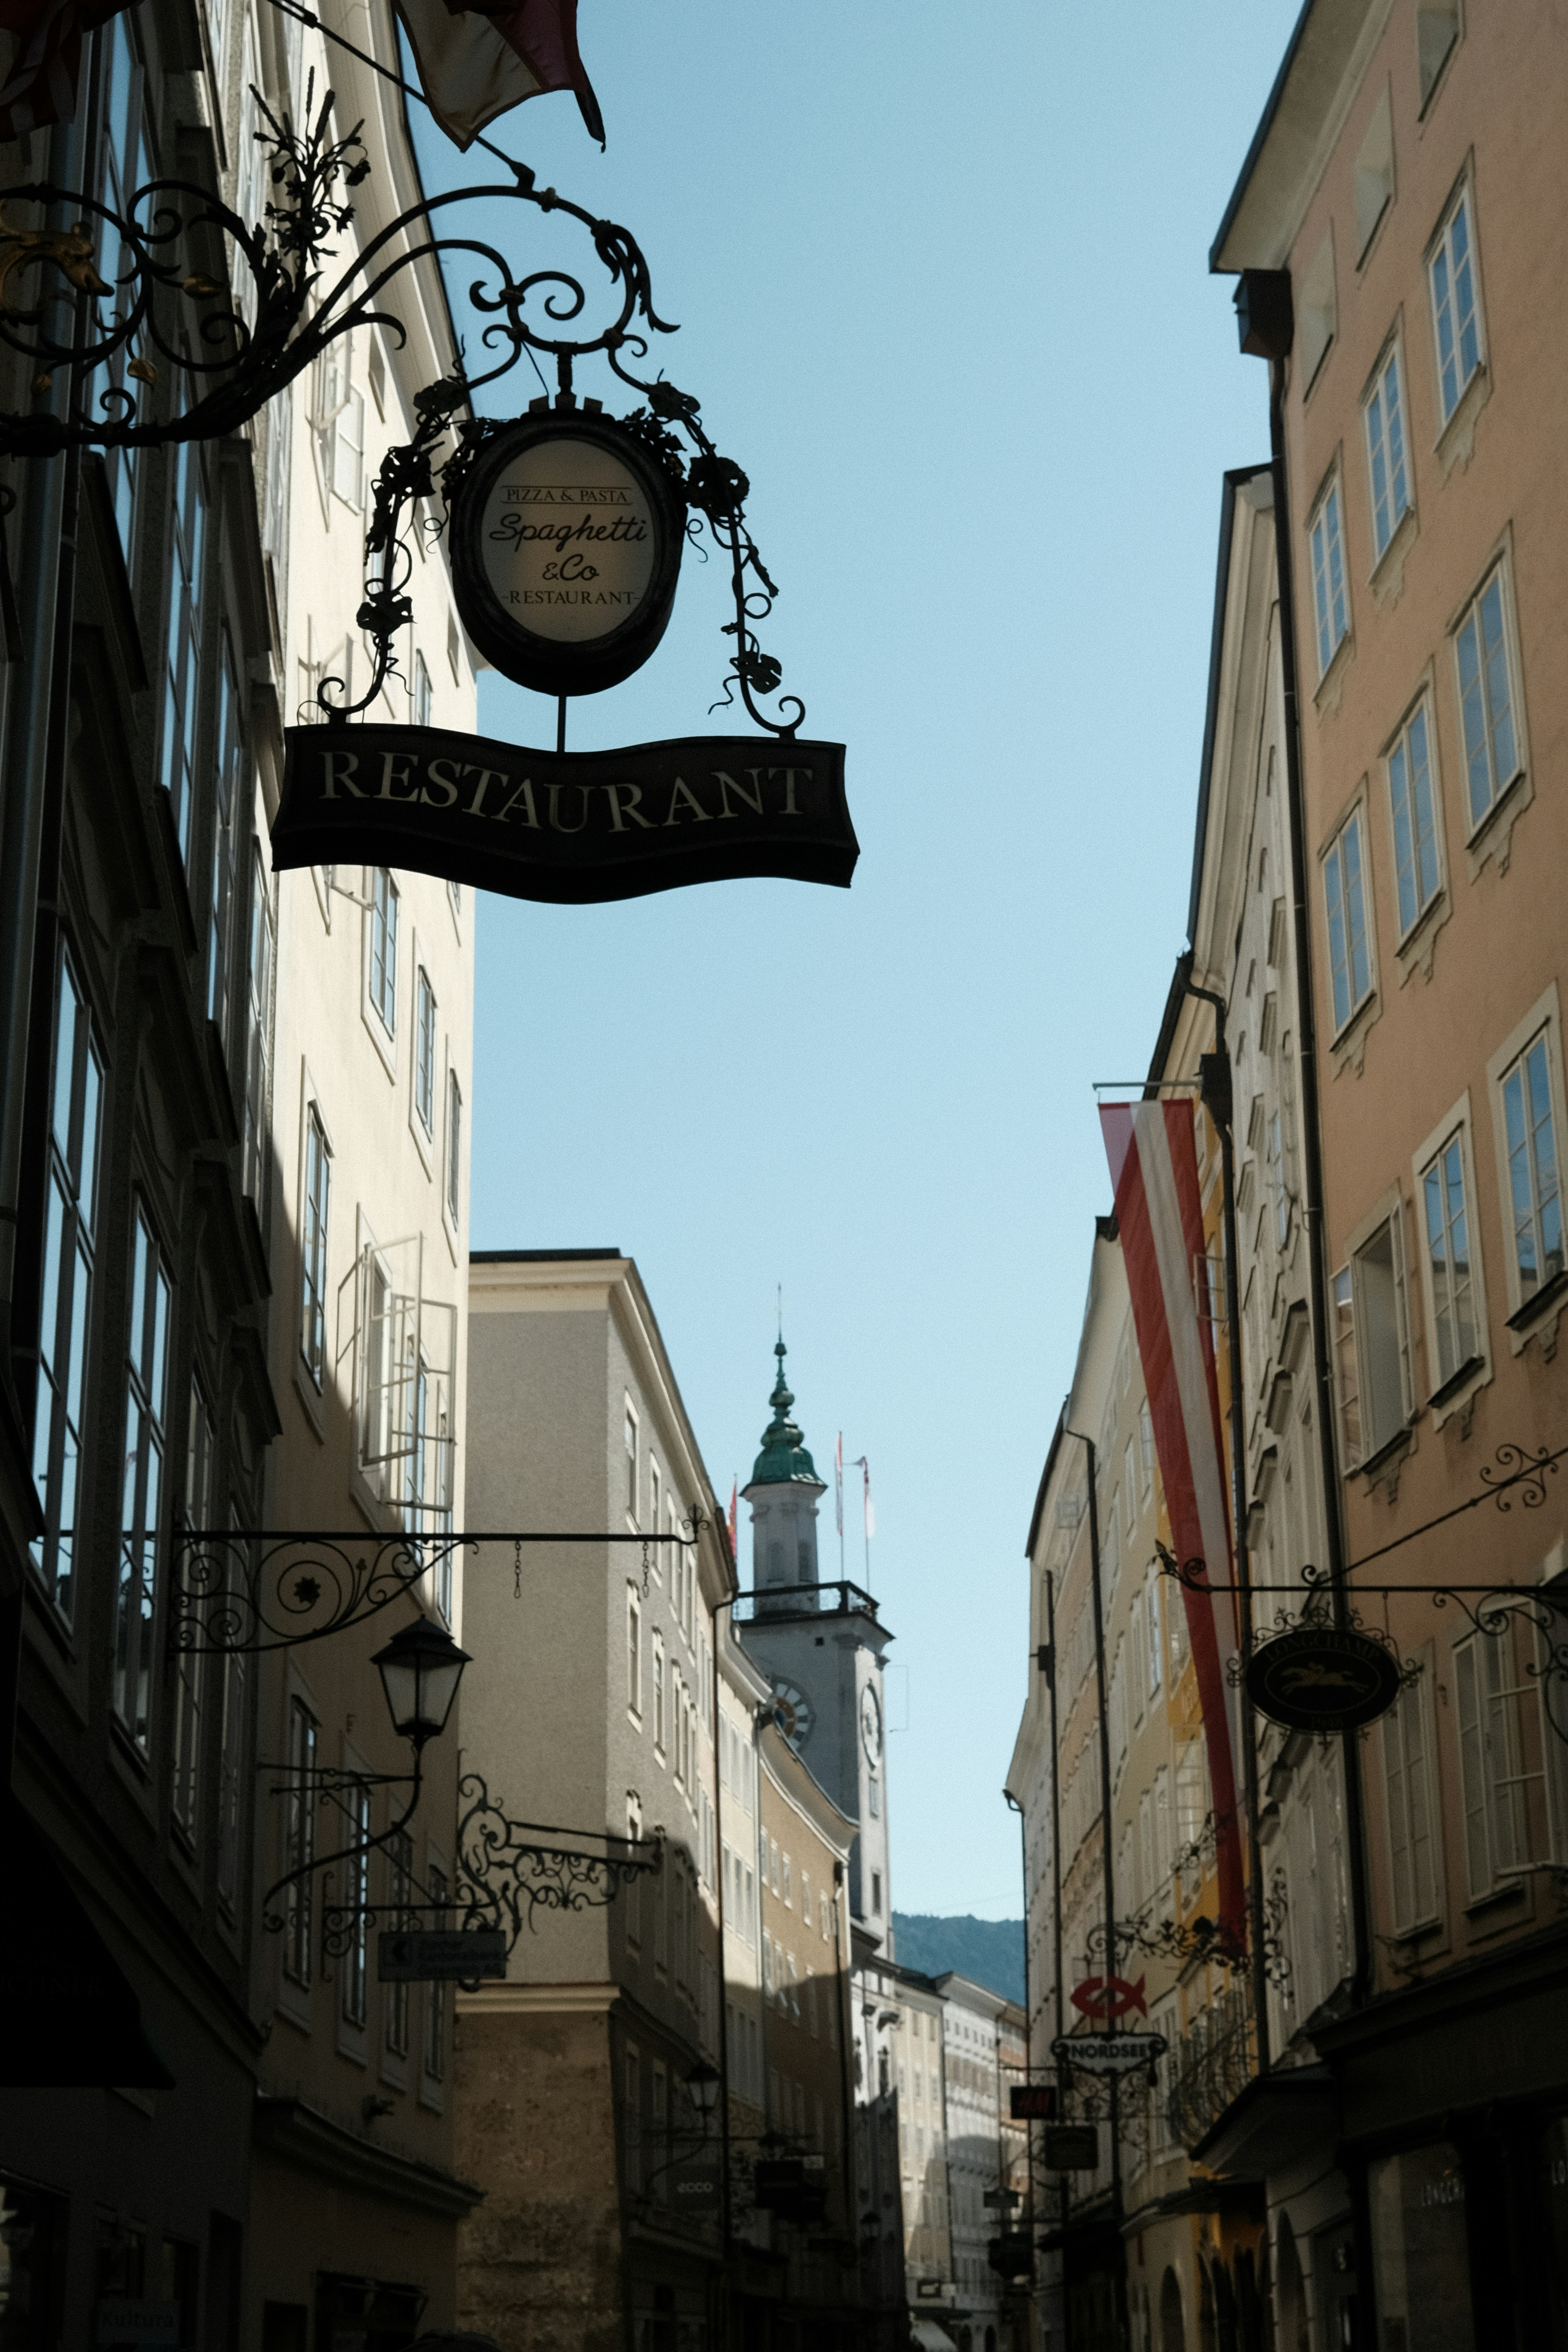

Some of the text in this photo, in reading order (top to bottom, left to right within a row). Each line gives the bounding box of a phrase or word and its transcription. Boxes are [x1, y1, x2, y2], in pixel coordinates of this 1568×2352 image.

[507, 489, 628, 502] PIZZA & PASTA
[490, 513, 648, 552] Spaghetti
[542, 554, 599, 581] &Co
[317, 751, 814, 833] RESTAURANT
[1265, 1633, 1381, 1661] LONGCHAMP
[1072, 2044, 1146, 2058] NORDSEE
[103, 2309, 174, 2328] Kultura
